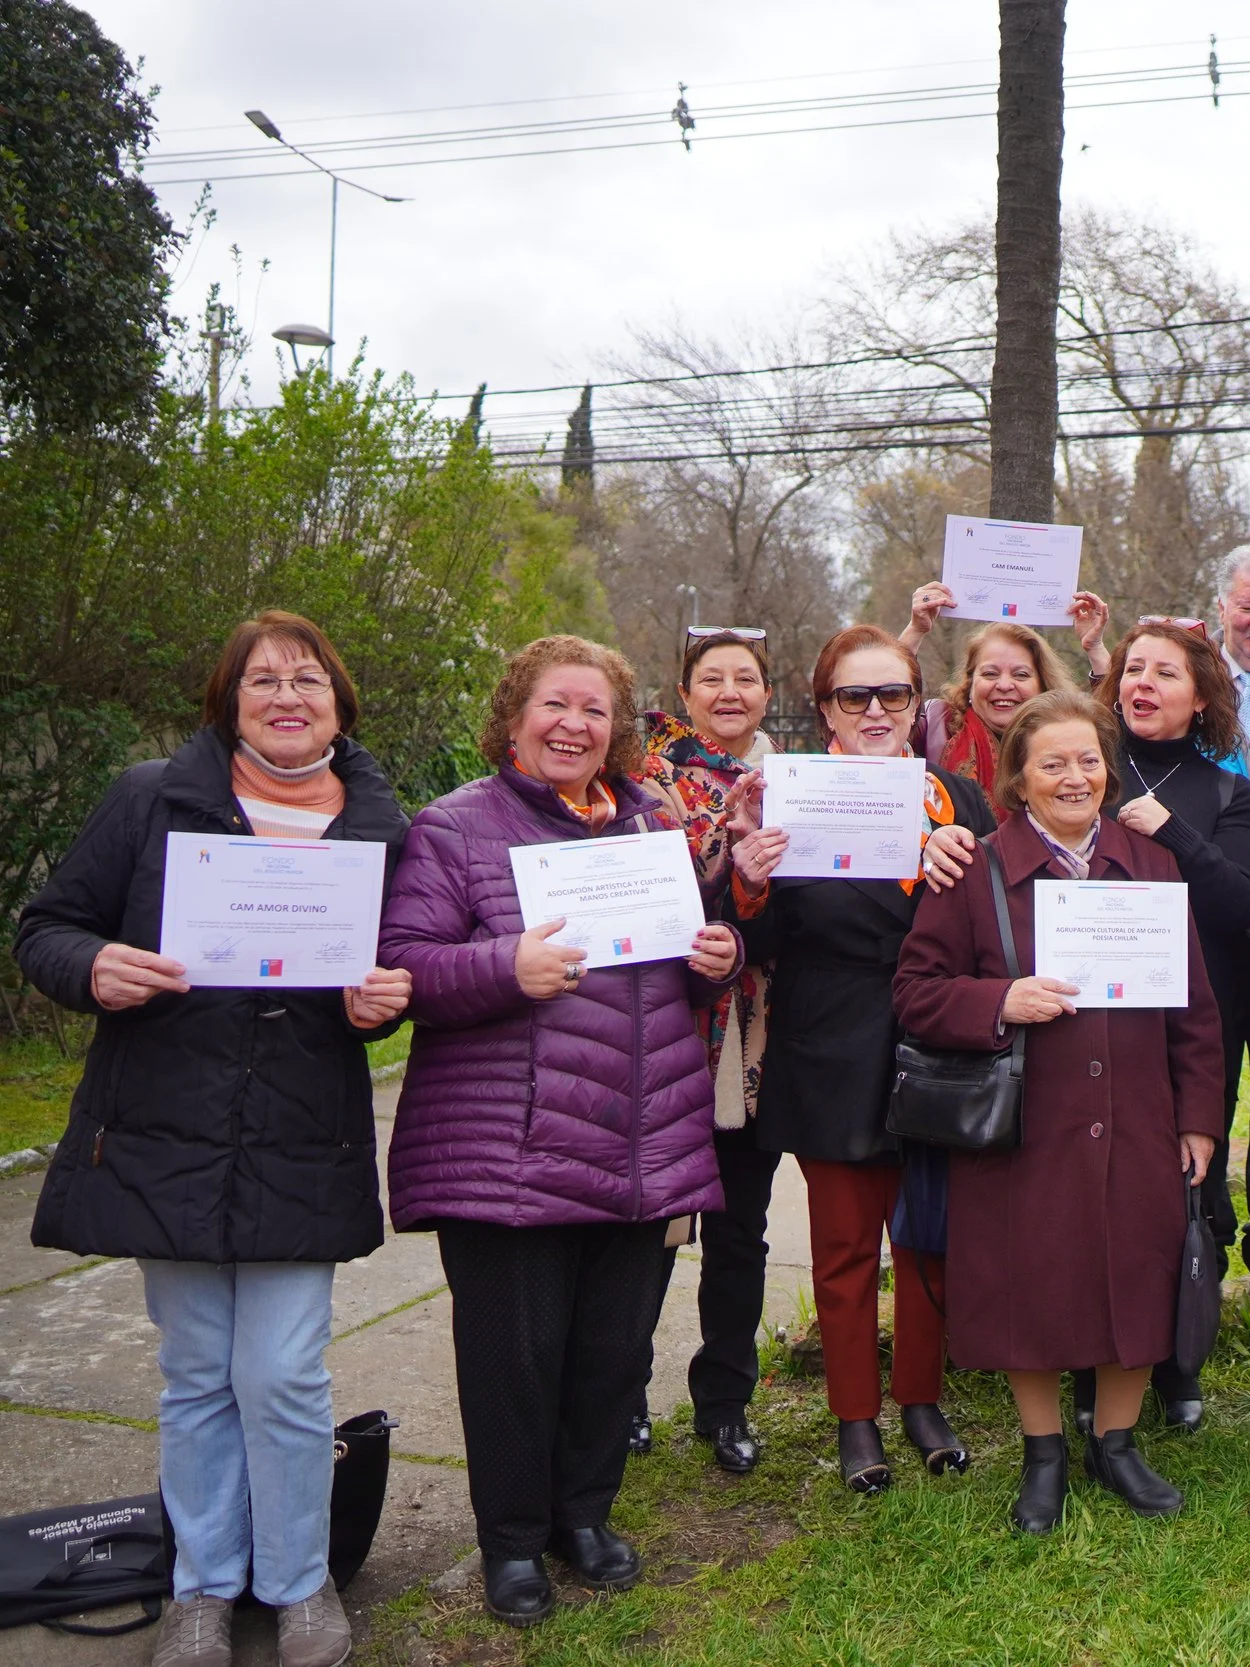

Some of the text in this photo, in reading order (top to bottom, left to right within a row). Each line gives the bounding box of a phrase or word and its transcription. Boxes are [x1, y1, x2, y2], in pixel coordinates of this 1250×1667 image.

[1007, 564, 1034, 572] EMANUEL
[595, 880, 632, 892] ARTÍSTICA
[640, 876, 677, 886] CULTURAL
[580, 888, 650, 902] MANOS CREATIVAS
[230, 903, 327, 913] CAM AMOR DIVINO
[96, 1507, 146, 1520] Regional
[28, 1519, 78, 1536] Mayores
[43, 1515, 132, 1540] Consejo Asesor
